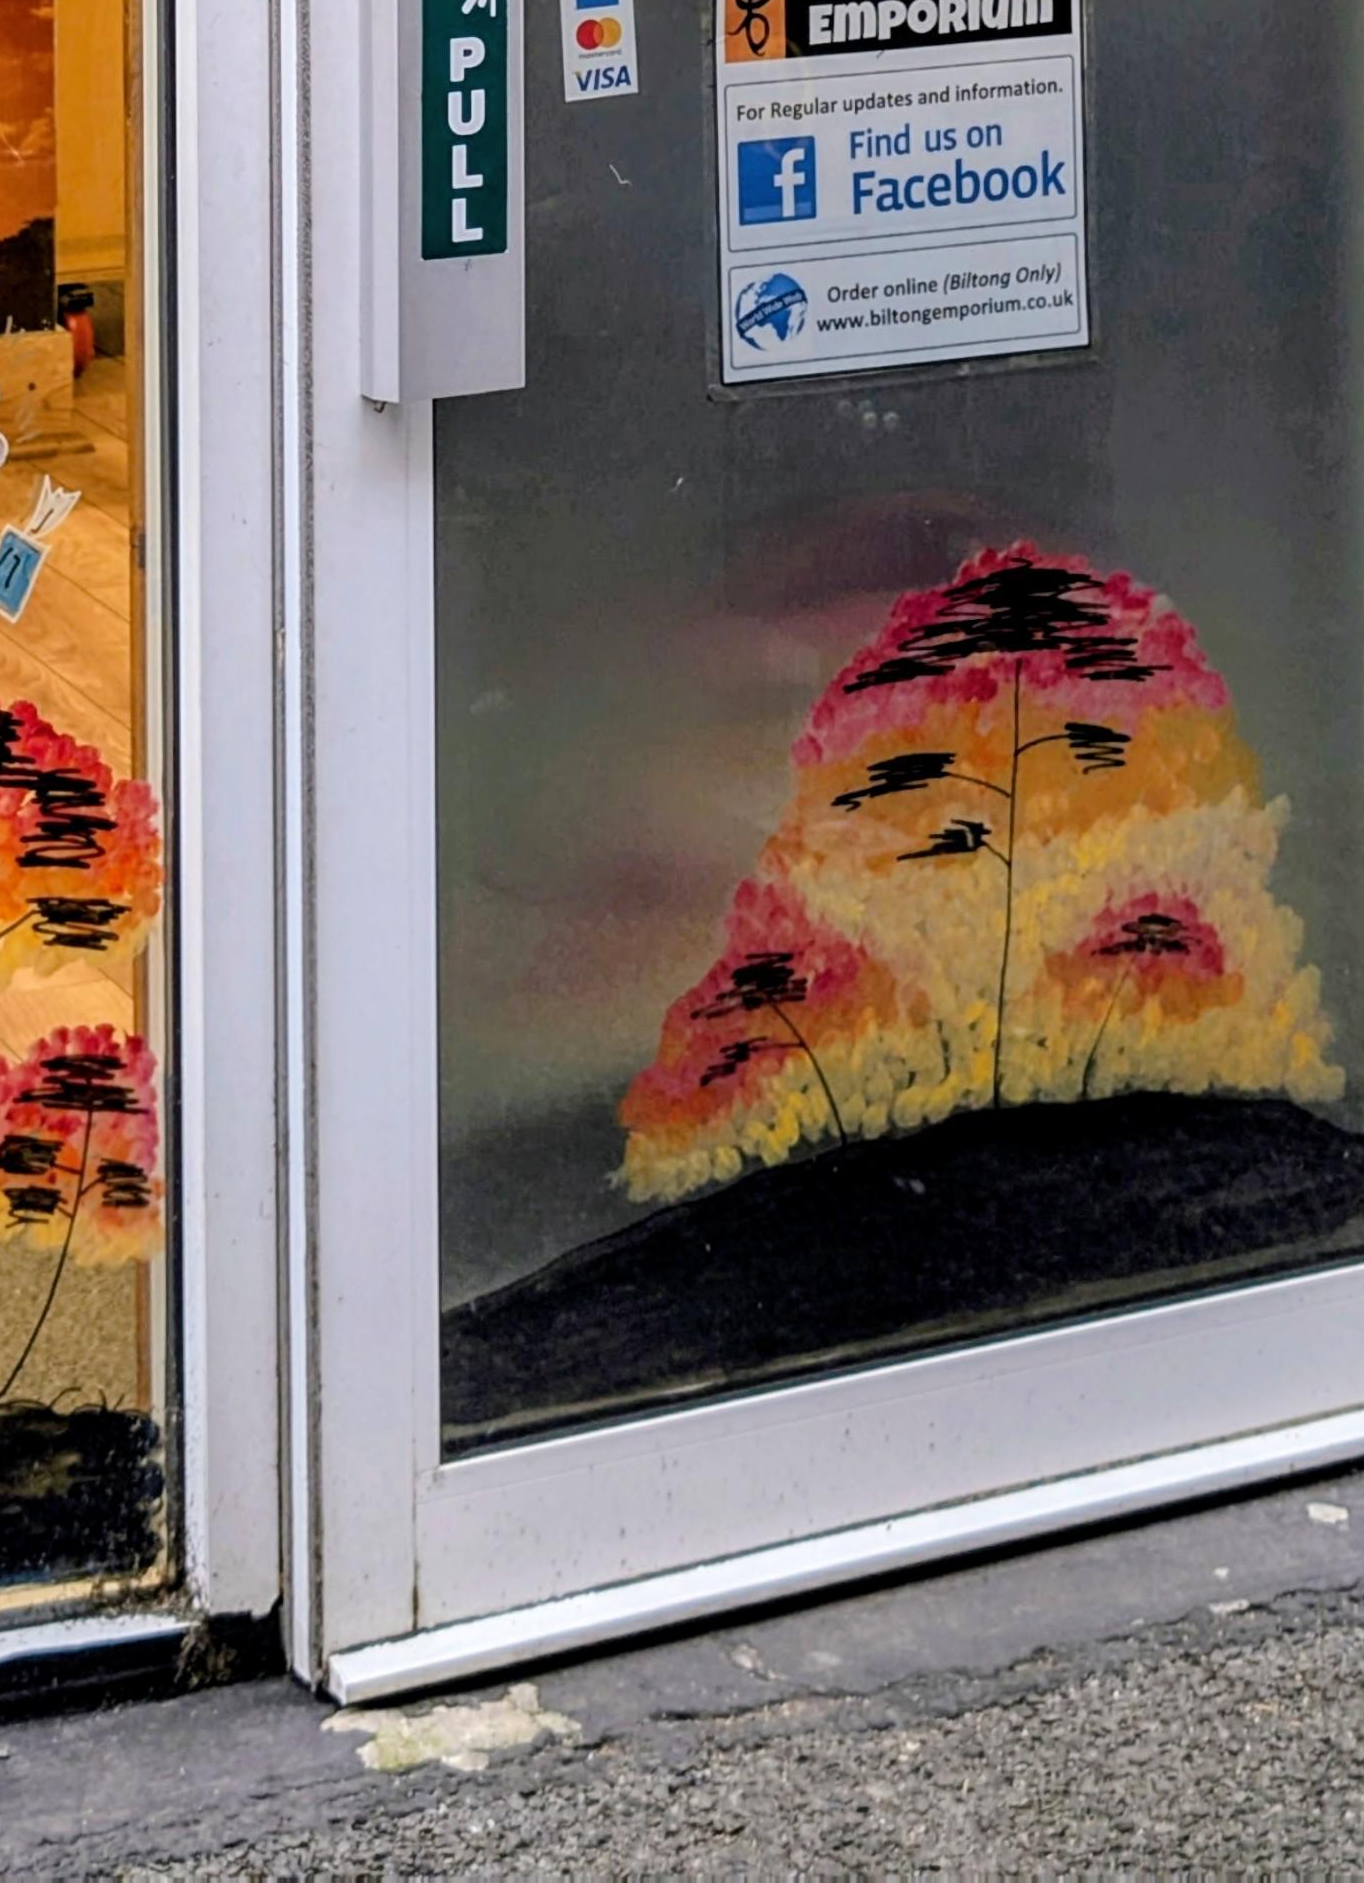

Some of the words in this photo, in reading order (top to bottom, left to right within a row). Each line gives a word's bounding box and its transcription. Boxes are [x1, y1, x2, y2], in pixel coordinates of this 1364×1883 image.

[578, 49, 622, 60] mastercard
[574, 65, 632, 92] VISA
[737, 103, 766, 122] For
[770, 98, 838, 120] Regular
[842, 89, 913, 114] updates
[917, 85, 951, 105] and
[955, 79, 1064, 102] information.
[448, 36, 486, 243] PULL
[850, 123, 912, 159] Find
[924, 128, 957, 152] us
[966, 124, 1003, 148] on
[852, 150, 1066, 216] Facebook
[827, 280, 879, 304] Order
[883, 276, 939, 299] online
[943, 270, 1011, 296] (Biltong
[1015, 262, 1062, 287] Only)
[817, 290, 1074, 333] www.biltongemporium.co.uk
